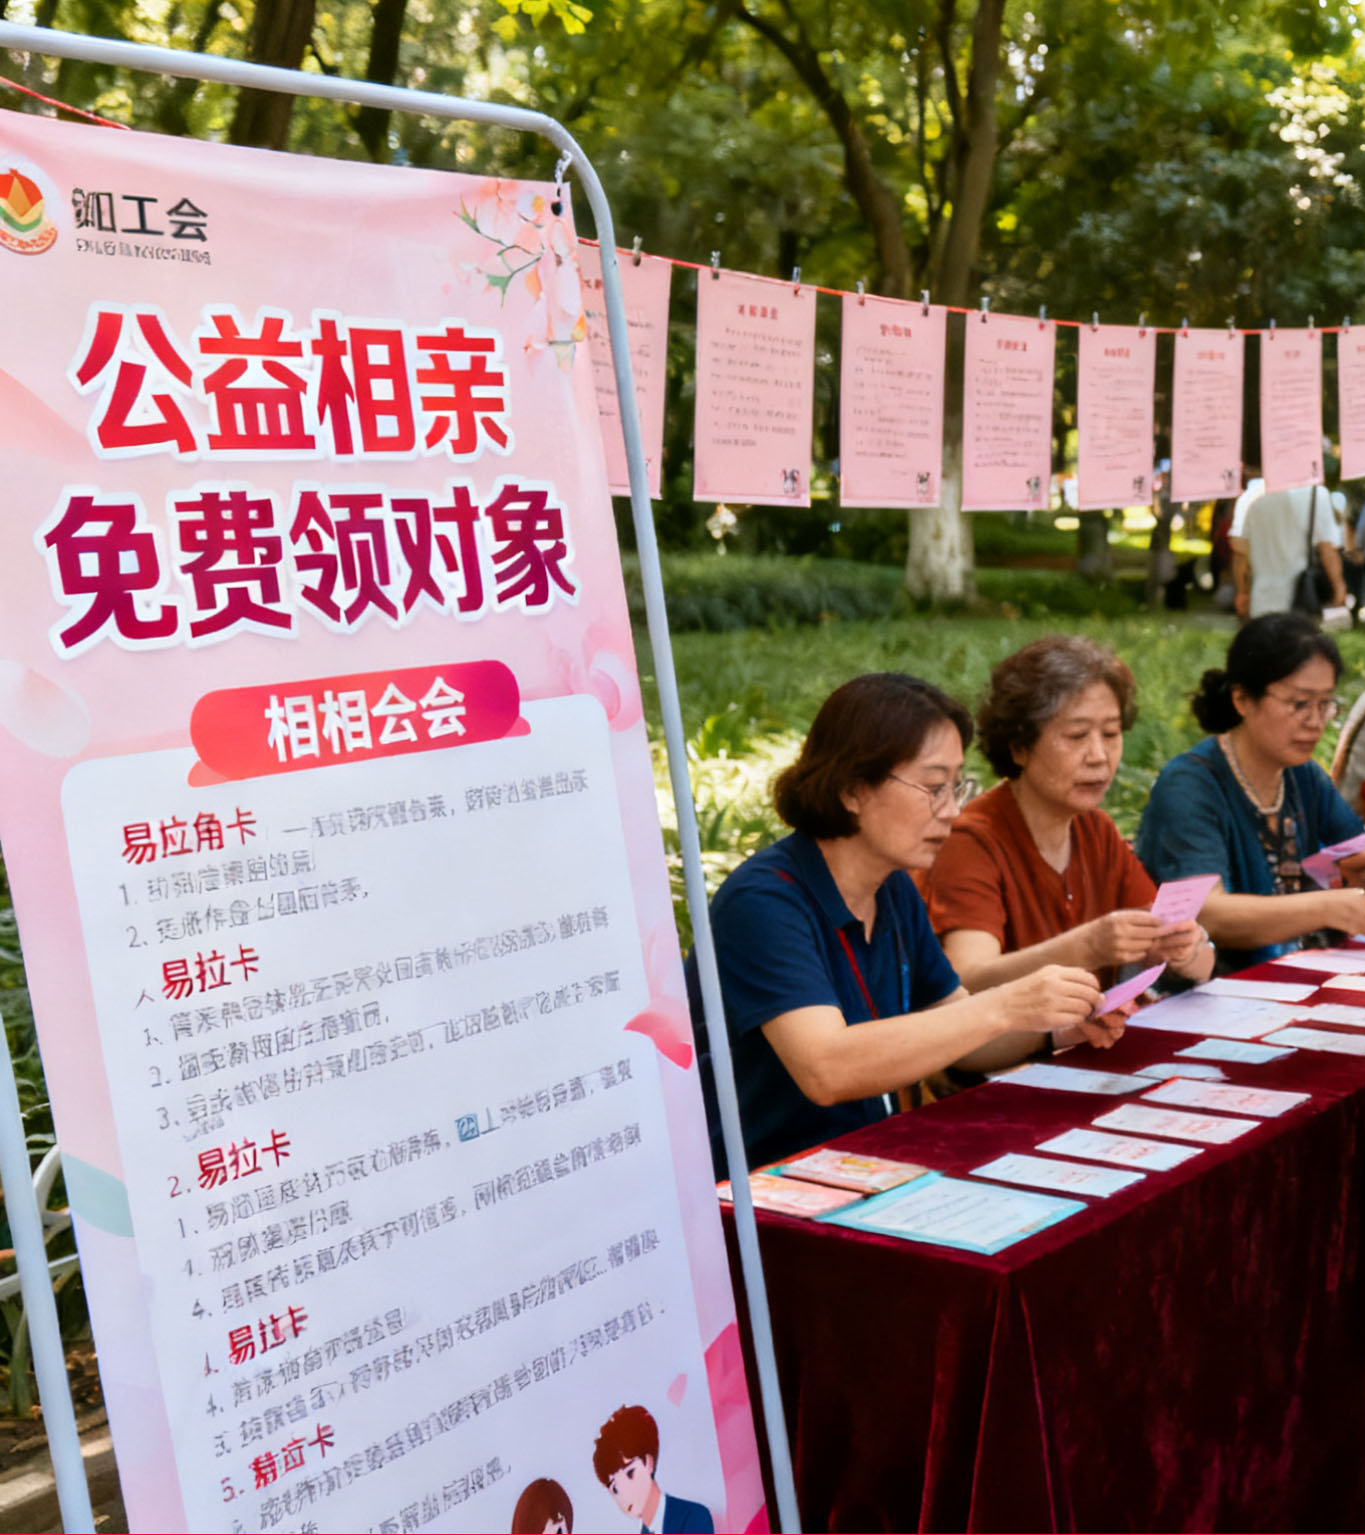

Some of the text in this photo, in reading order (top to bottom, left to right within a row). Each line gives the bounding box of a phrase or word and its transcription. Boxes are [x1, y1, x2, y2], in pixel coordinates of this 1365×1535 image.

[77, 311, 508, 456] 公益相亲
[43, 483, 577, 648] 免费领对象
[162, 943, 260, 1001] 易拉卡
